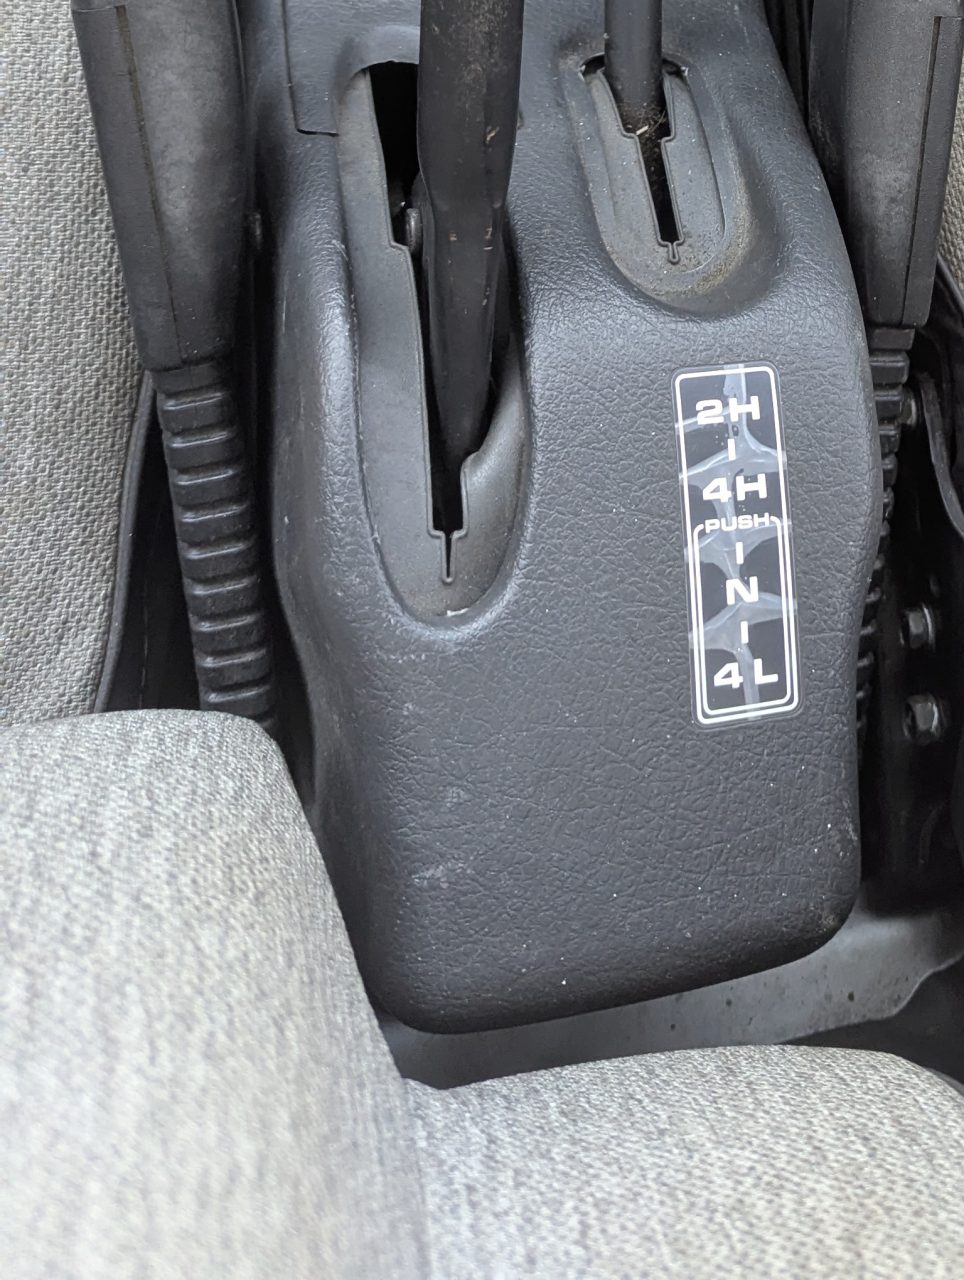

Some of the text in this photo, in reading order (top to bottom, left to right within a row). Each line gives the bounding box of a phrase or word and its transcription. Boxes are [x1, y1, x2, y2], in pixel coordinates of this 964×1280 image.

[696, 395, 761, 425] 2H
[702, 473, 768, 503] 4H
[705, 513, 770, 533] PUSH
[726, 576, 760, 605] N
